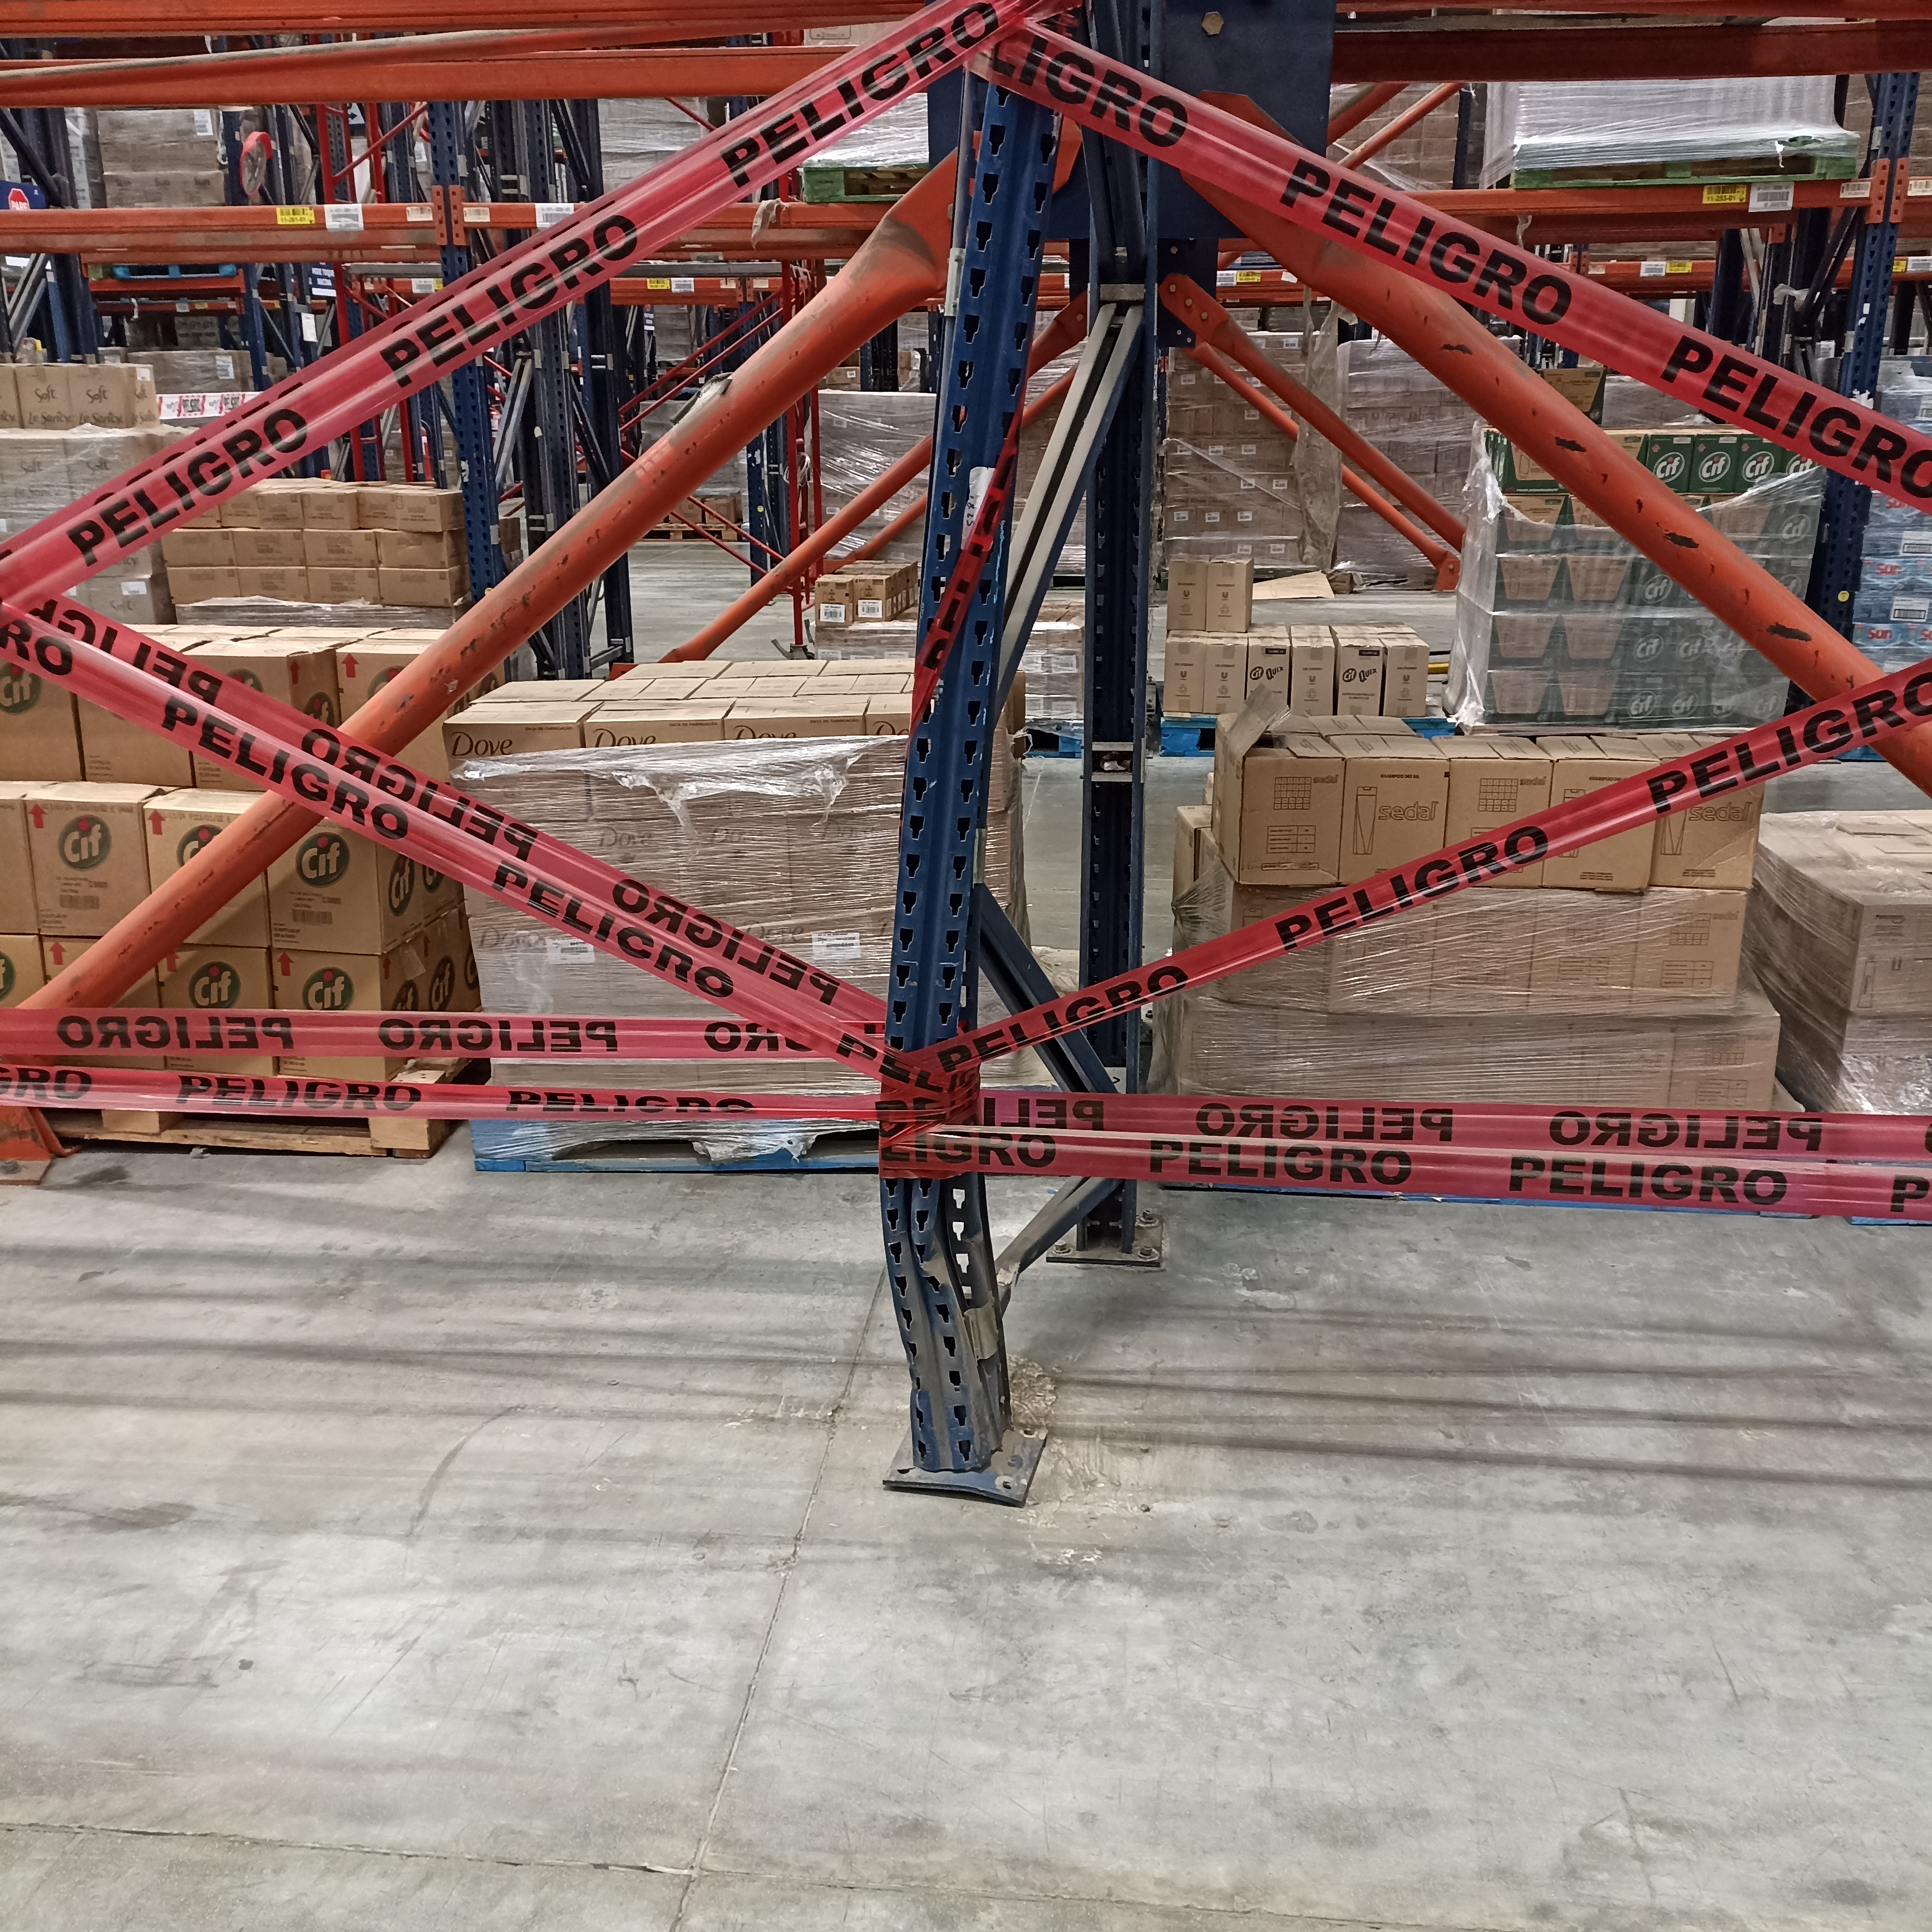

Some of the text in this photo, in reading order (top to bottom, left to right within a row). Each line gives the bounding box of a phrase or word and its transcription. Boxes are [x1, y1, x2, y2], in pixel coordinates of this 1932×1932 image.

[721, 2, 999, 188] PELIGRO
[990, 35, 1188, 147] LIGRO
[1279, 157, 1572, 326] PELIGRO
[381, 215, 638, 388] PELIGRO
[1660, 335, 1932, 499] PELIGRO
[67, 409, 308, 566] PELIGRO
[1656, 456, 1681, 478] Cif
[1701, 456, 1726, 478] Cif
[1745, 456, 1770, 478] Cif
[451, 732, 513, 756] Dove
[1647, 671, 1932, 814] PELIGRO
[161, 695, 408, 840] PELIGRO
[1378, 801, 1439, 821] sedal
[1688, 801, 1753, 821] sedal
[64, 819, 101, 862] Cif
[302, 836, 340, 879] Cif
[1275, 826, 1549, 950] PELIGRO
[195, 966, 232, 1006] Cif
[308, 970, 344, 1010] Cif
[938, 966, 1189, 1073] PELIGRO
[176, 1075, 422, 1111] PELIGRO
[506, 1091, 755, 1113] PELIGRO
[881, 1131, 1056, 1167] LIGRO
[1150, 1139, 1412, 1185] PELIGRO
[1509, 1156, 1787, 1205] PELIGRO
